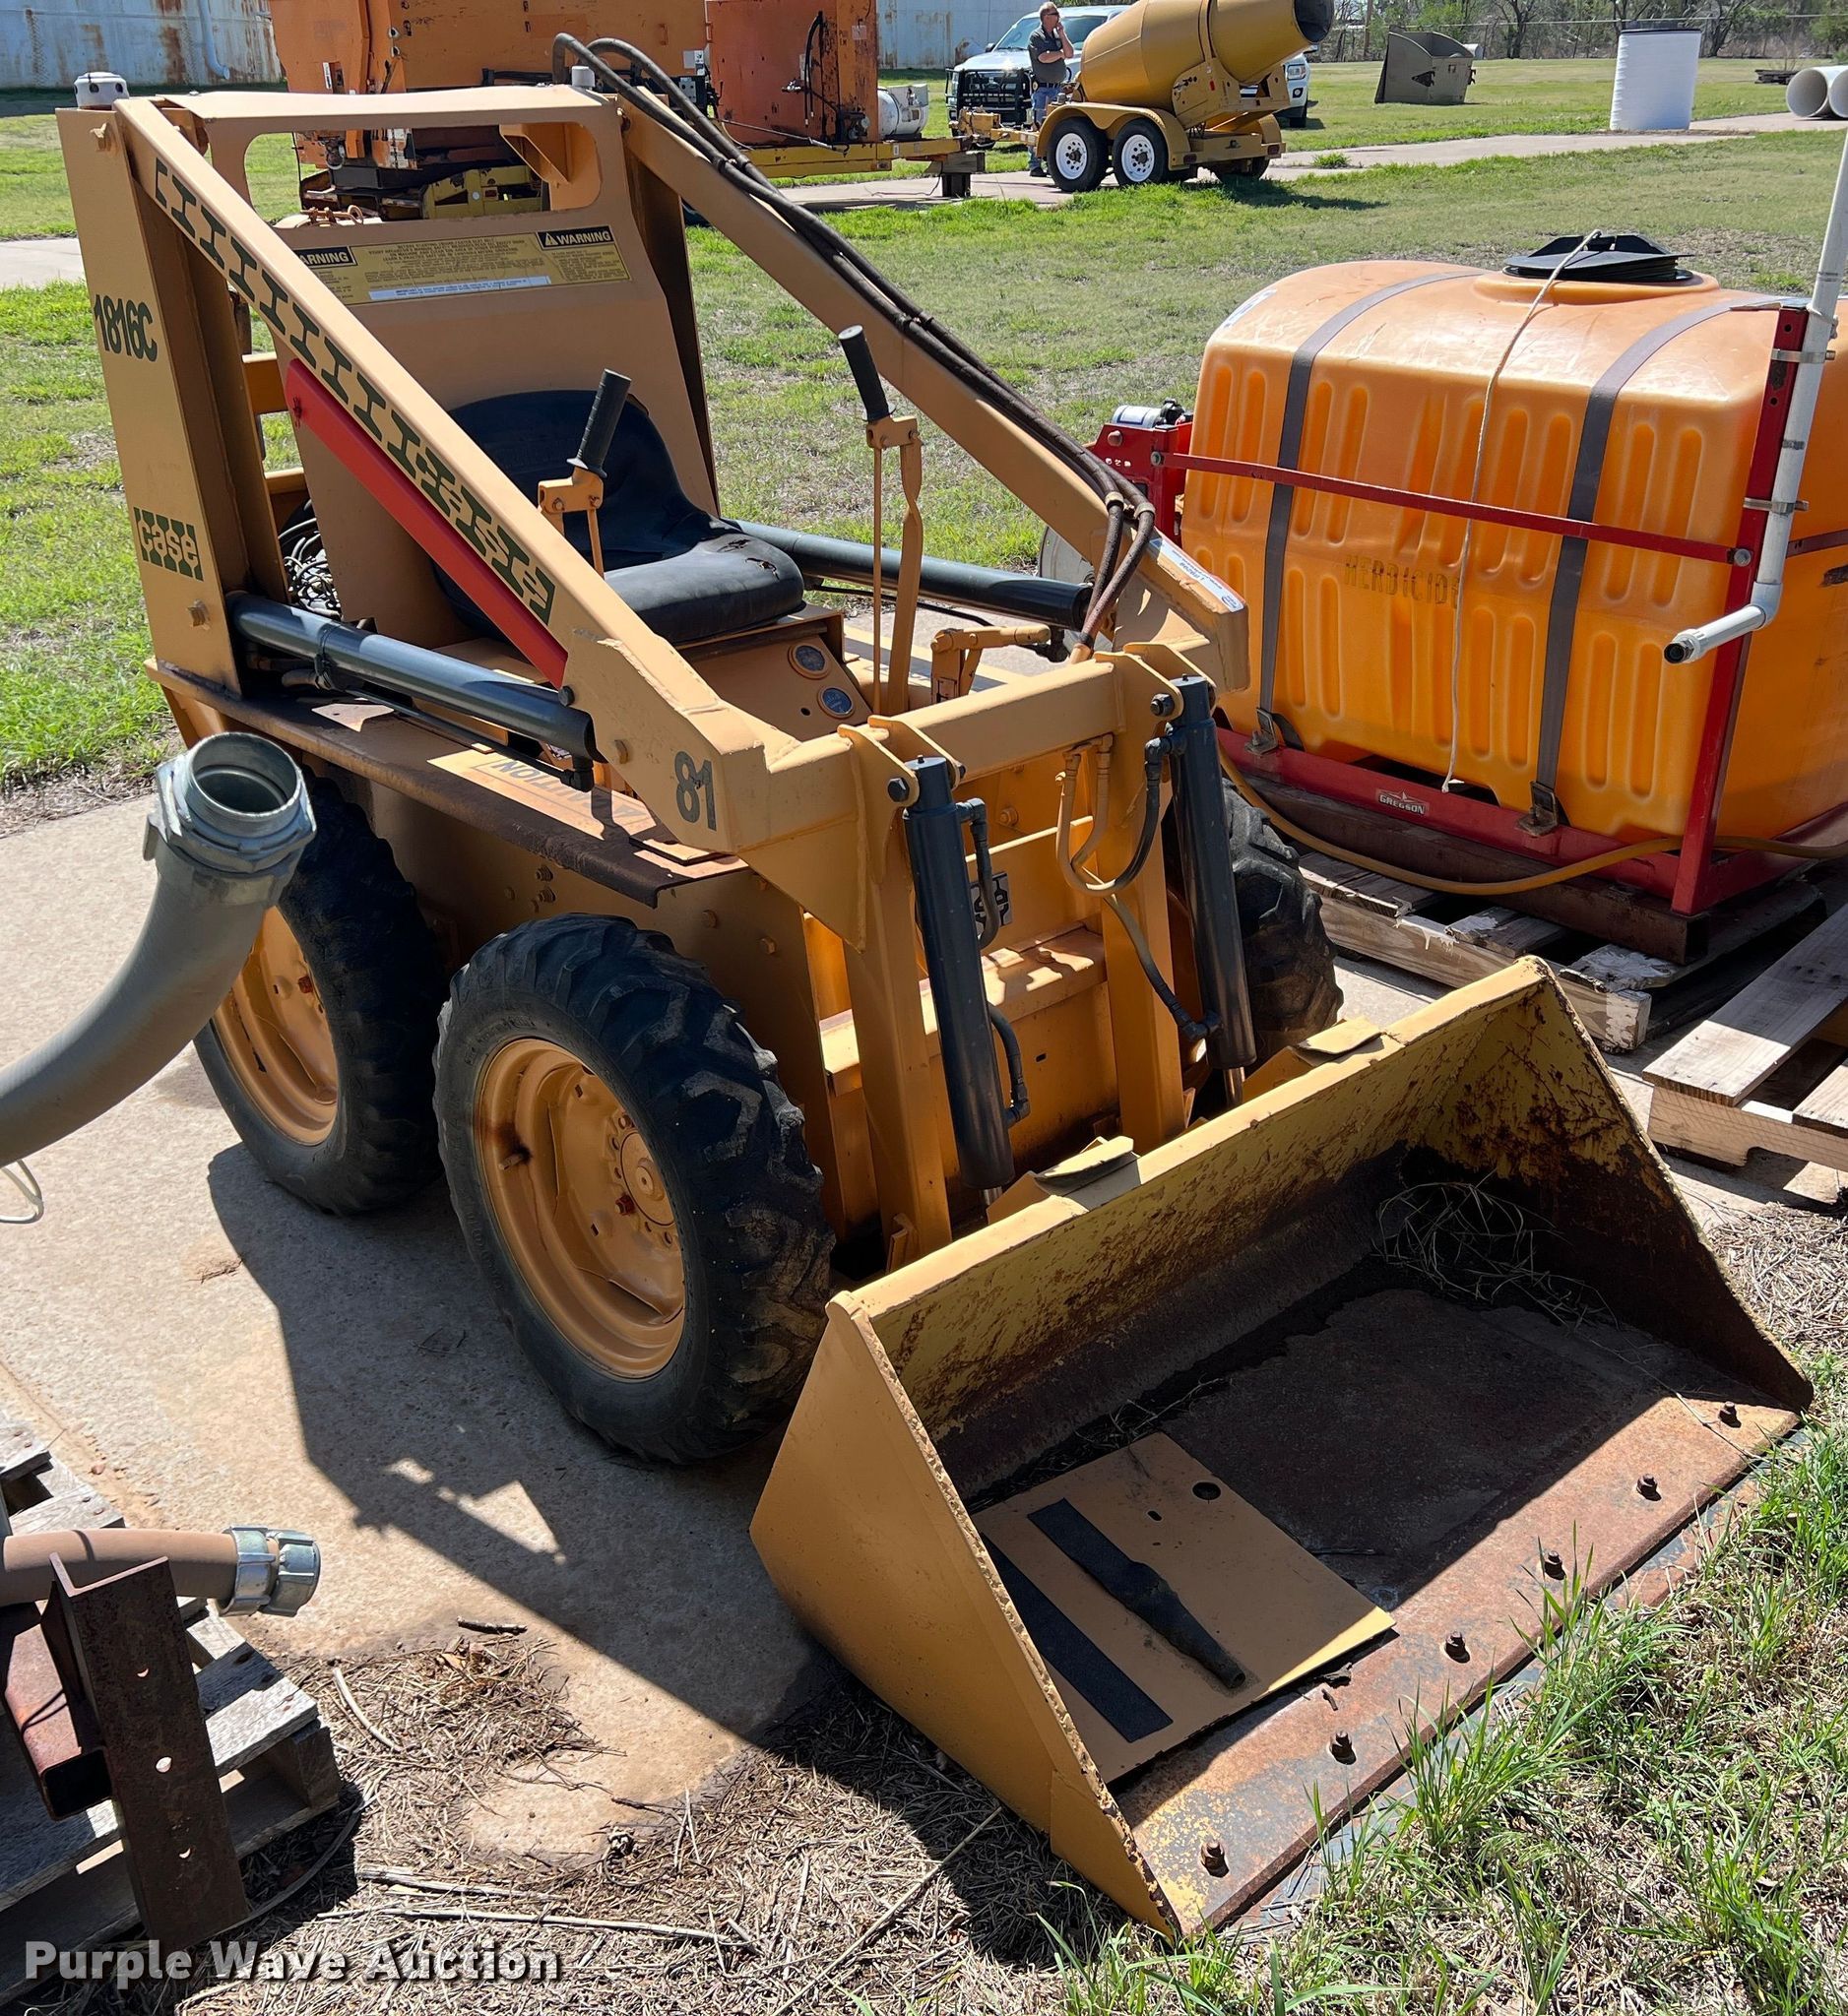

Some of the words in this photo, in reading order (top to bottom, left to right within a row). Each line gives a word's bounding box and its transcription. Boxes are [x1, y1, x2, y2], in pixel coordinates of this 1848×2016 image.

[556, 230, 611, 246] WARNING
[300, 251, 350, 266] ARNING
[94, 293, 158, 362] 1816C
[674, 751, 717, 832] 81
[1379, 793, 1426, 816] GREGSON
